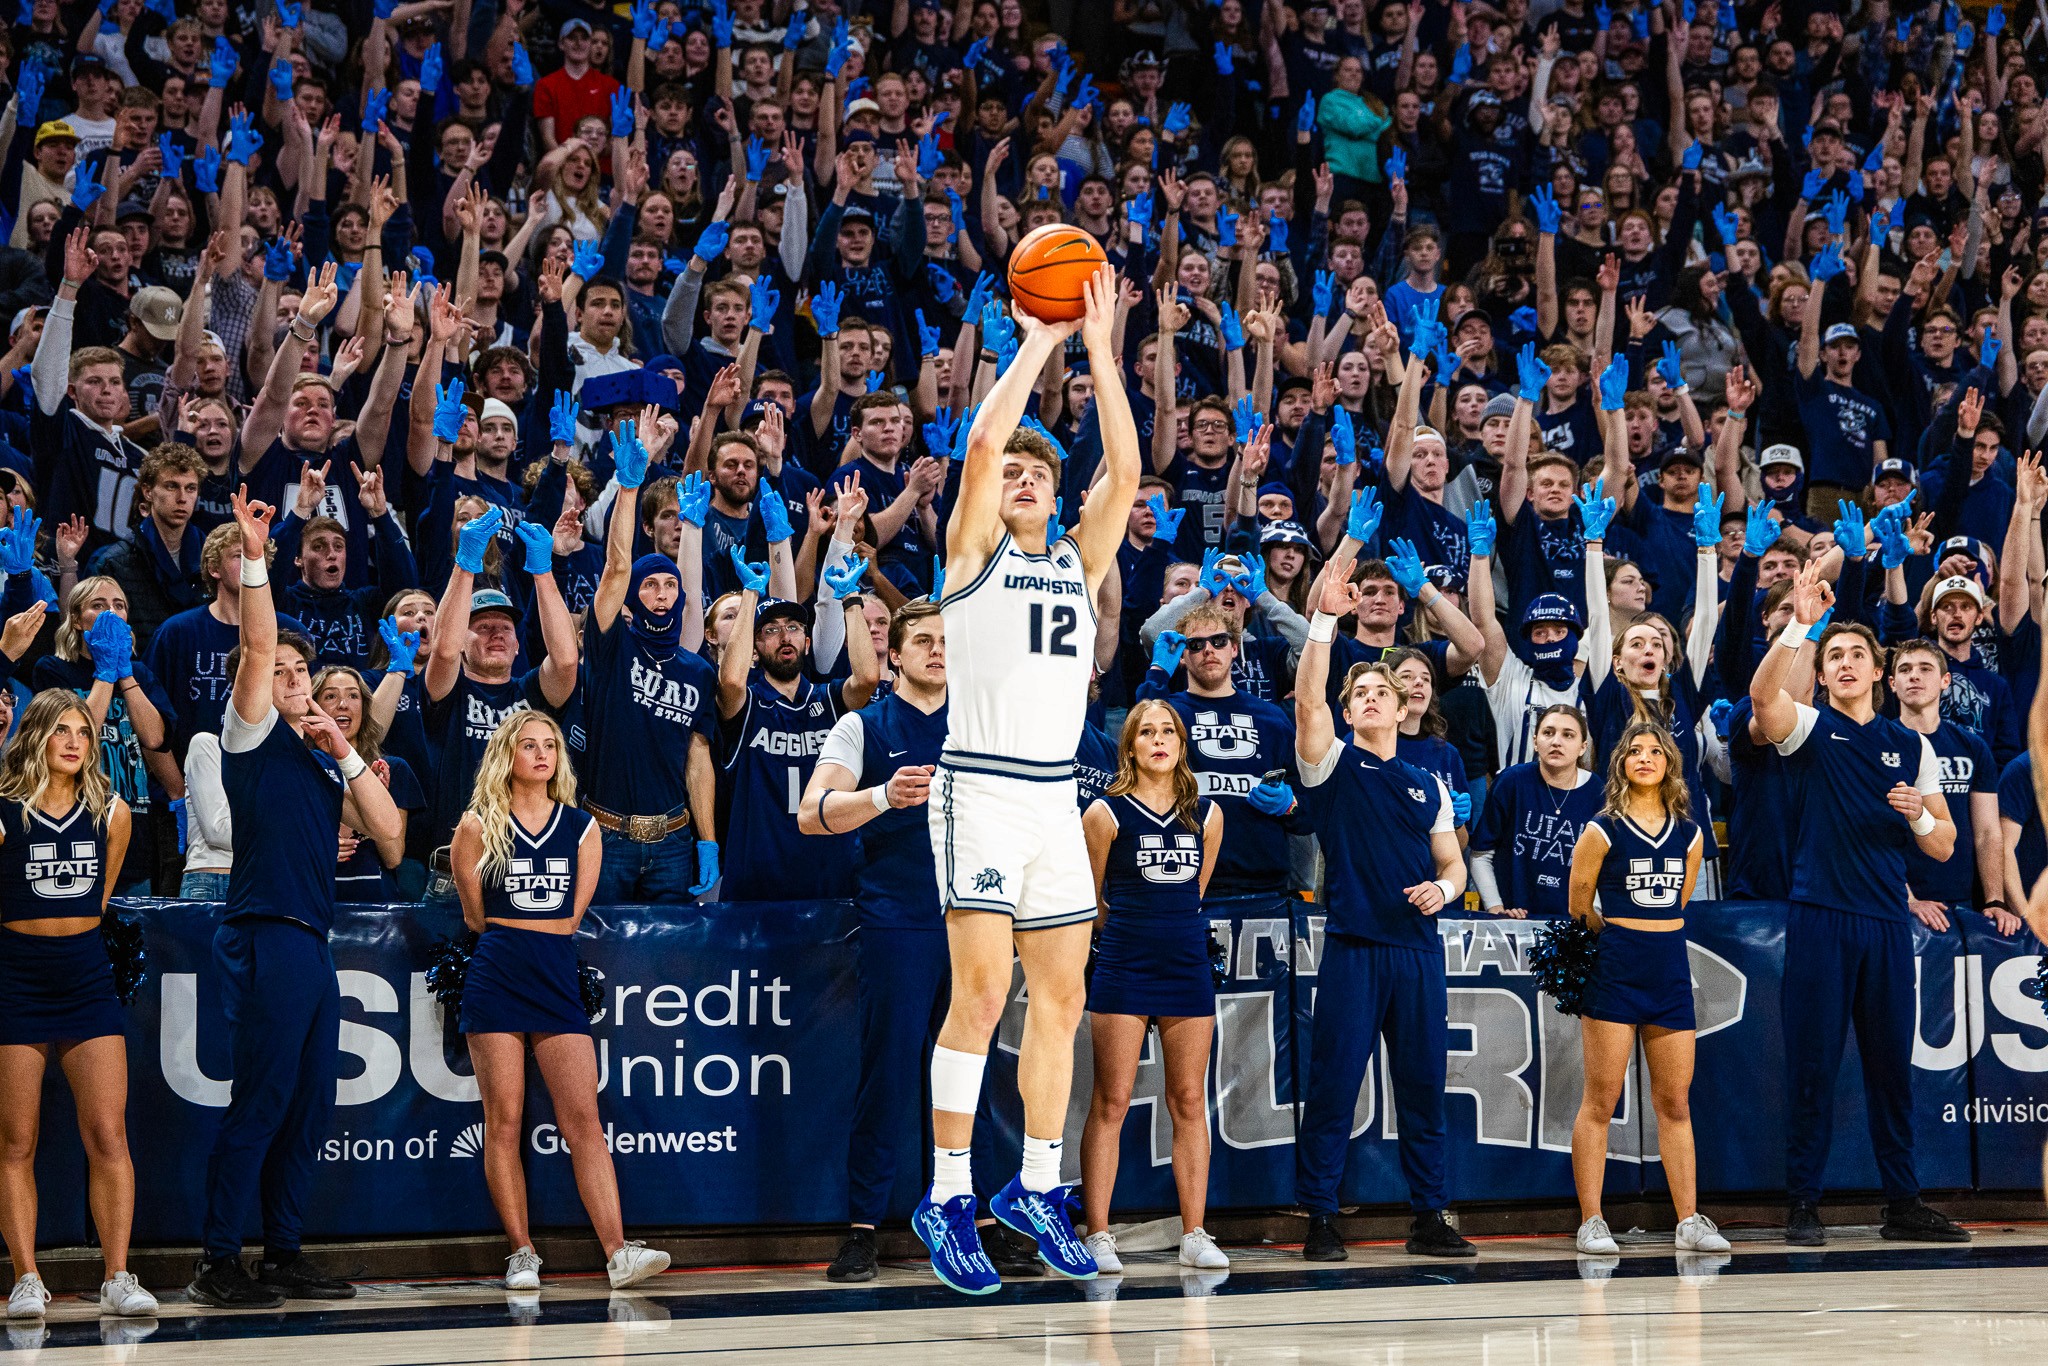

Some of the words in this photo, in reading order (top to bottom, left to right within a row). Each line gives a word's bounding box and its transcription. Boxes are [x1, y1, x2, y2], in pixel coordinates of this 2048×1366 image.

[1004, 574, 1050, 593] UTAH
[1532, 605, 1567, 617] HURD
[1028, 603, 1077, 658] 12
[1534, 648, 1563, 661] HURD
[465, 726, 496, 741] UTA
[749, 726, 831, 757] AGGIES
[1190, 724, 1260, 746] STATE
[1938, 756, 1973, 780] RD
[787, 766, 800, 814] 1
[1208, 774, 1250, 794] DAD
[1136, 849, 1200, 867] STATE
[25, 859, 99, 881] STATE
[1538, 873, 1561, 886] FOX
[504, 874, 571, 893] STATE
[1625, 873, 1685, 891] STATE
[1942, 1103, 1957, 1123] a
[405, 1129, 438, 1160] of
[530, 1122, 737, 1154] Godenwest
